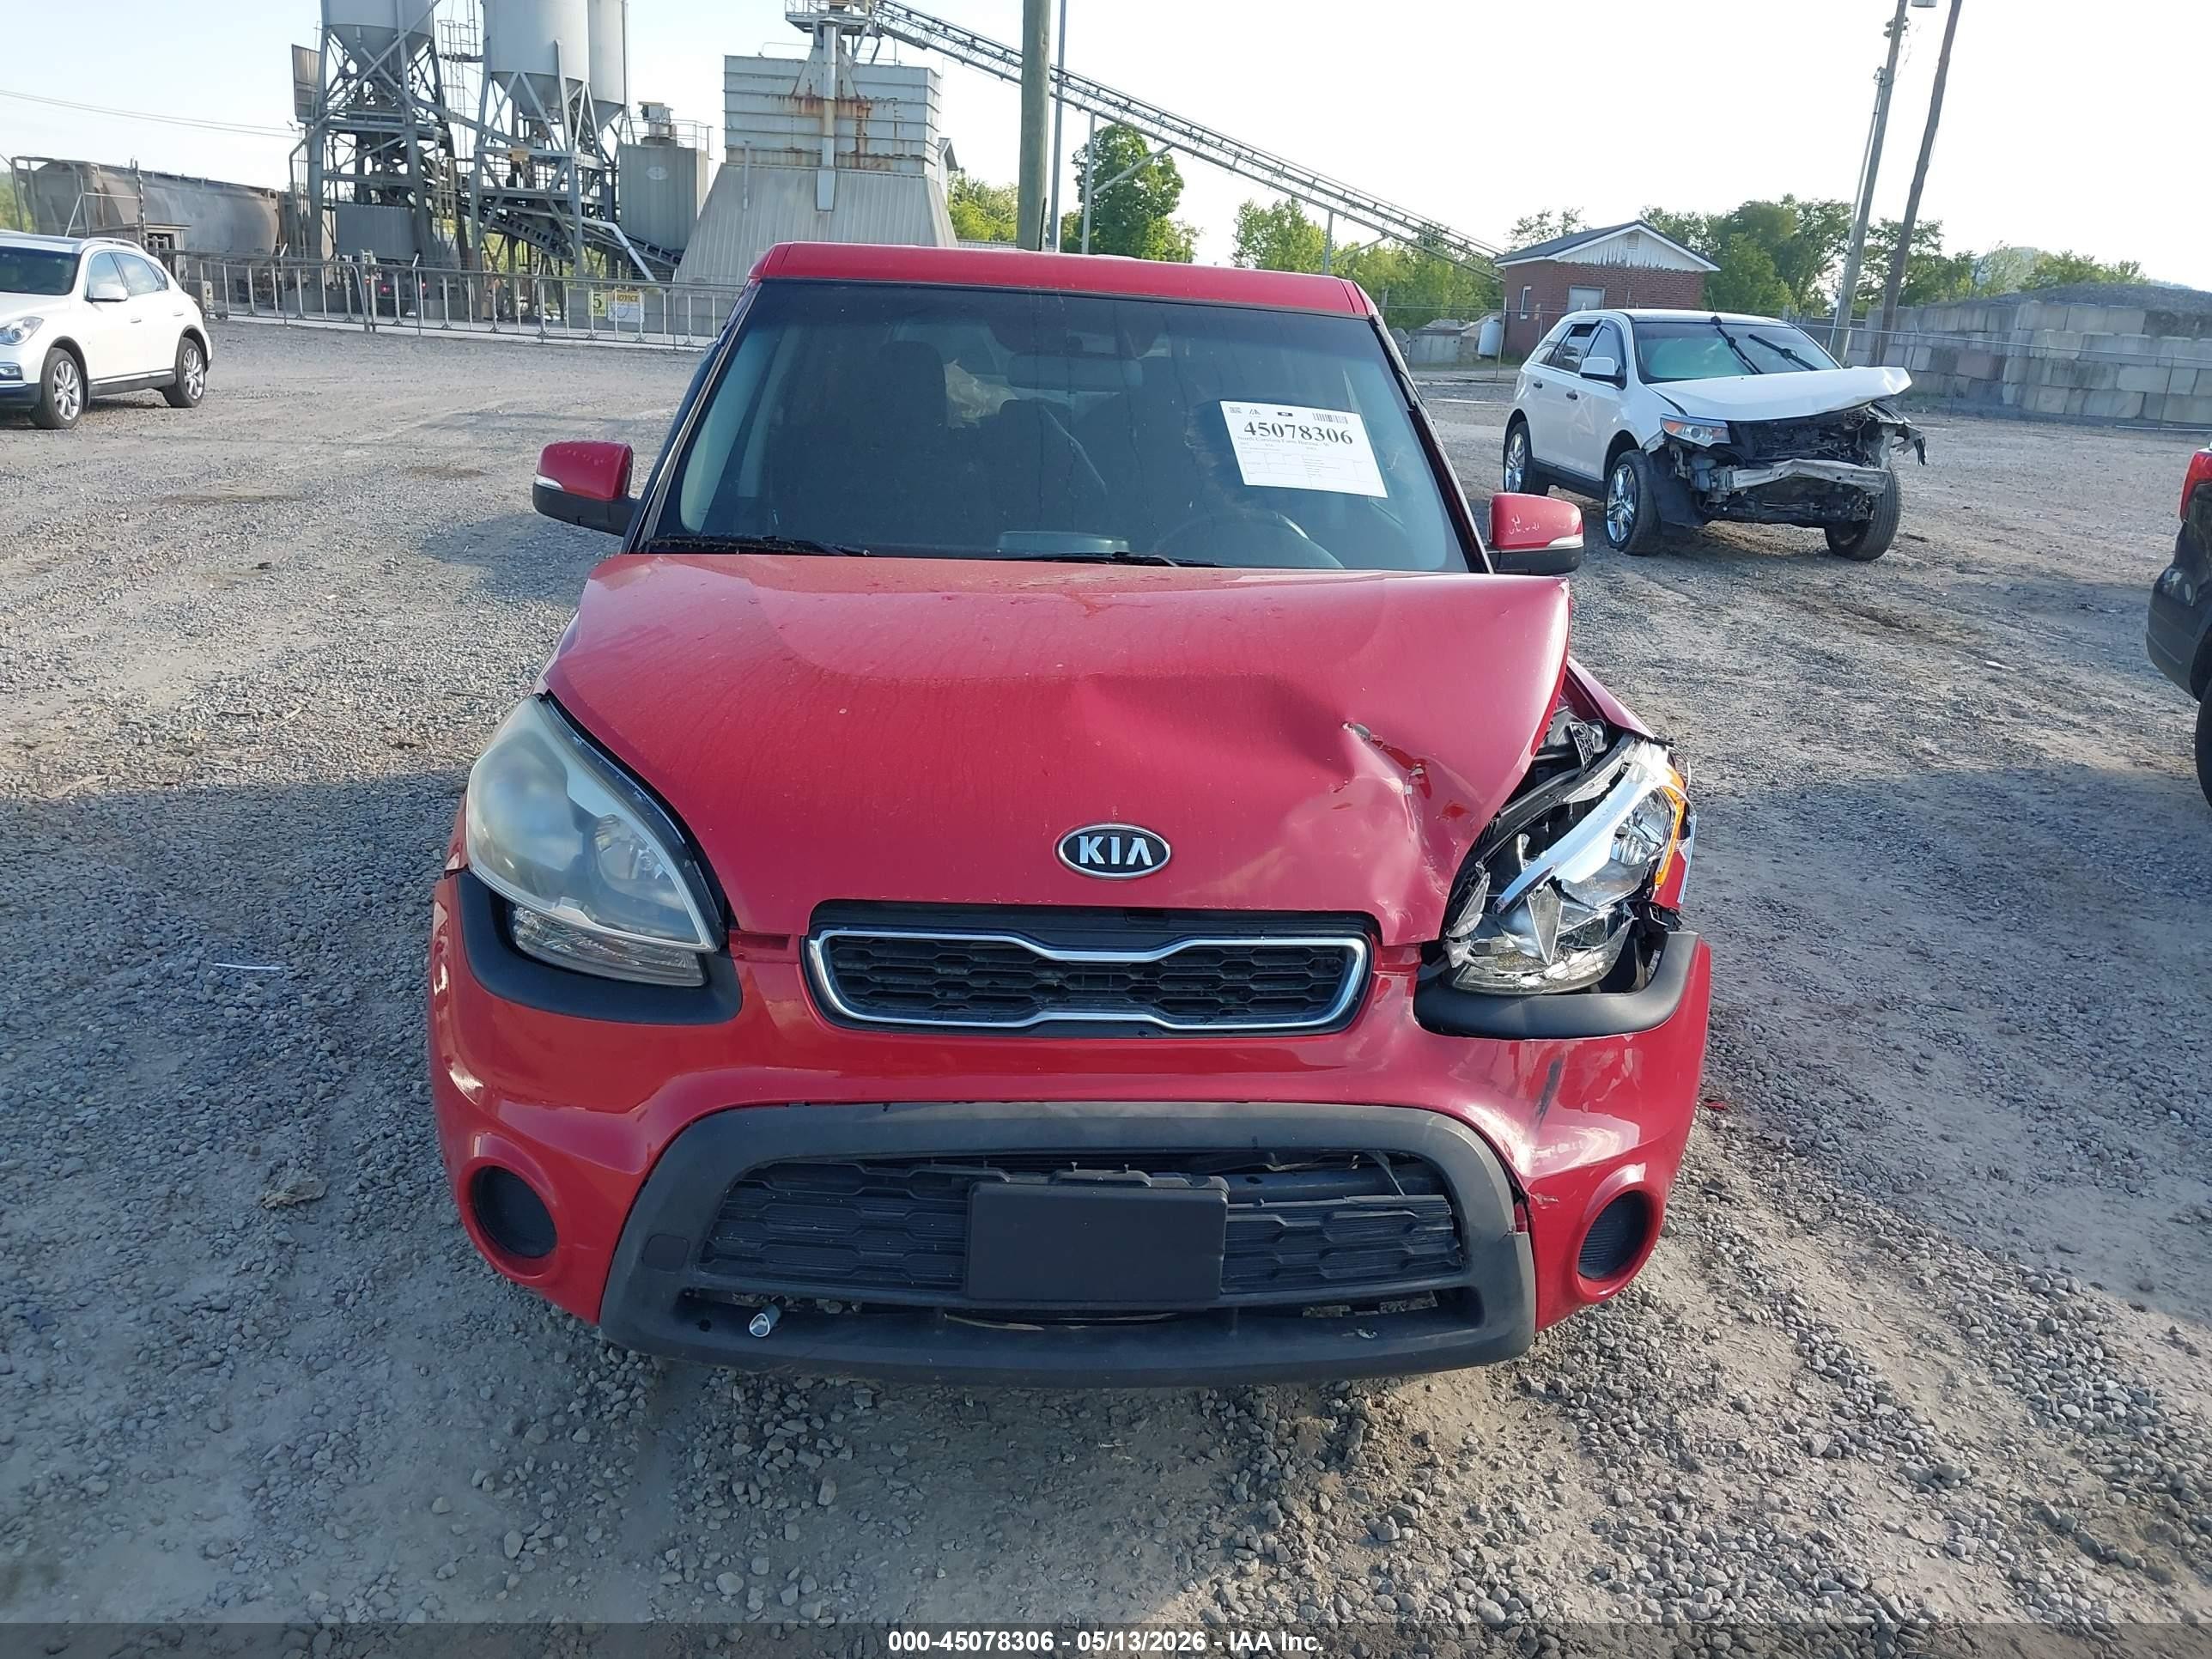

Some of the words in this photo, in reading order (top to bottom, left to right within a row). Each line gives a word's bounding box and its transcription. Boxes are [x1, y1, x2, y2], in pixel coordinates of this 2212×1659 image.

[592, 294, 602, 308] 5
[1243, 421, 1353, 445] 45078306
[1078, 836, 1153, 866] KIA
